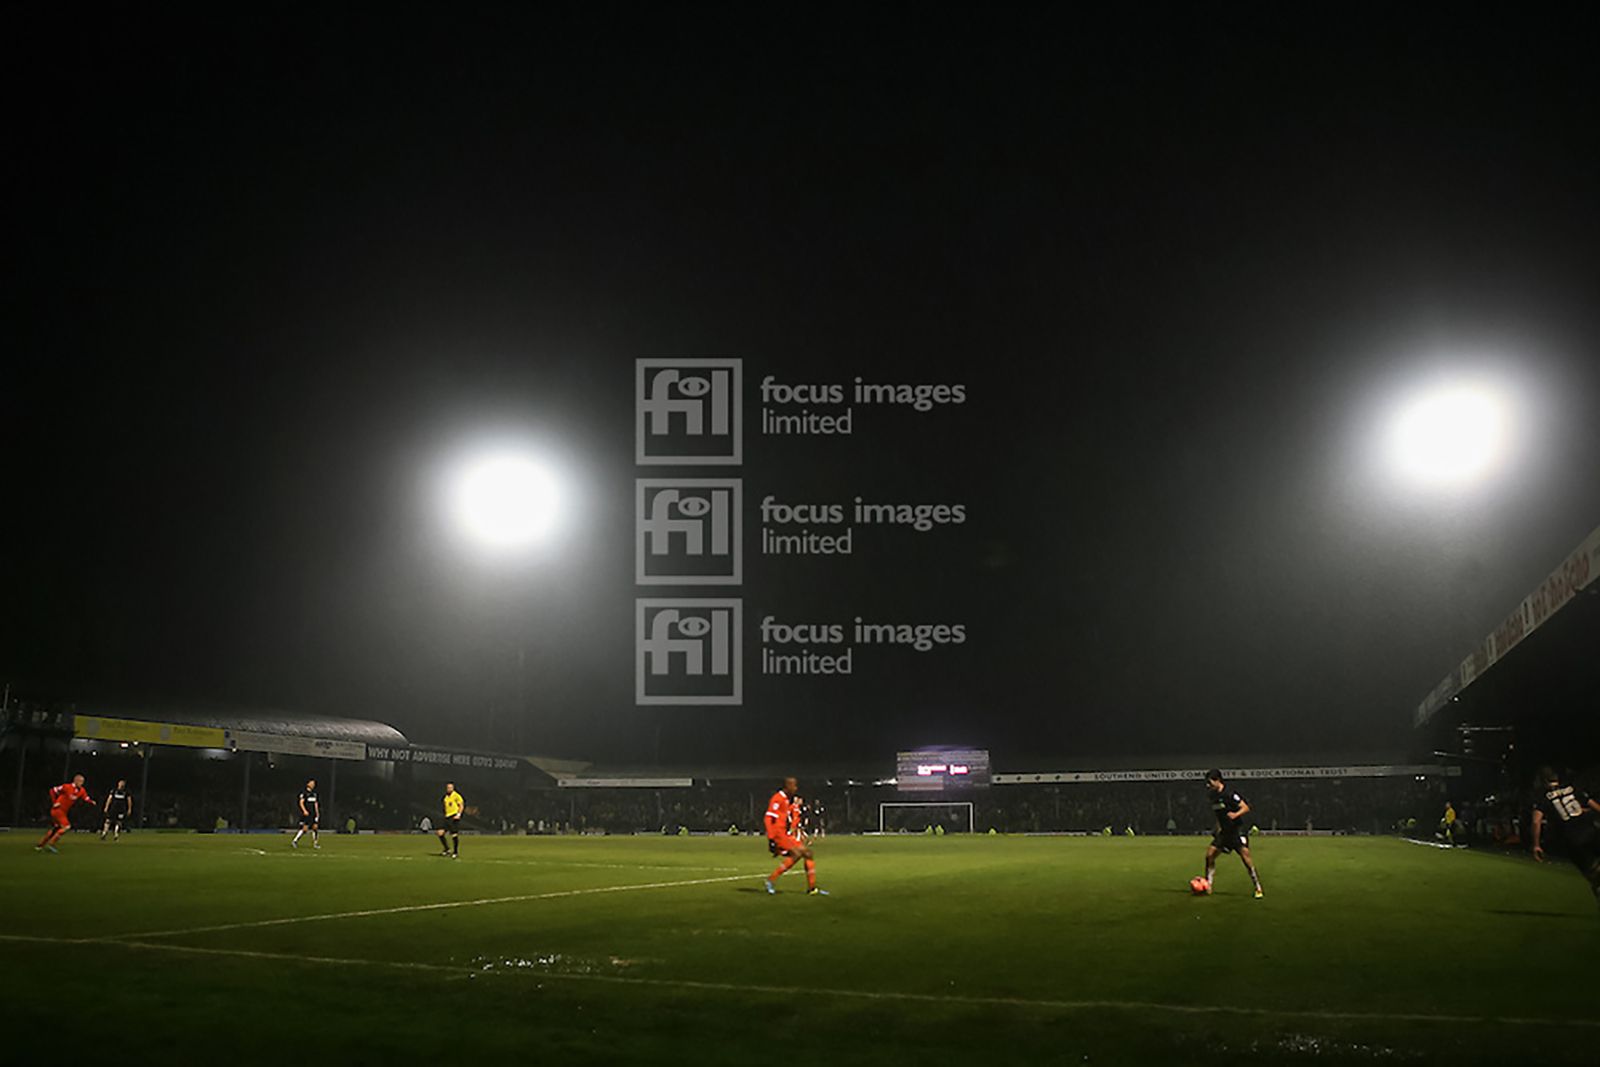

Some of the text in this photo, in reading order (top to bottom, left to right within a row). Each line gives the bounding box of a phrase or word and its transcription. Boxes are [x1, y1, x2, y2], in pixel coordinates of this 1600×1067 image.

[367, 746, 389, 759] WHY
[391, 749, 410, 760] NOT
[412, 750, 452, 765] ADVERTISE
[452, 754, 471, 766] HERE
[1094, 772, 1142, 780] SOUTHEND
[1144, 771, 1177, 779] UNITED
[1241, 770, 1247, 778] &
[1250, 768, 1316, 777] EDUCATIONAL
[1320, 767, 1348, 776] TRUST
